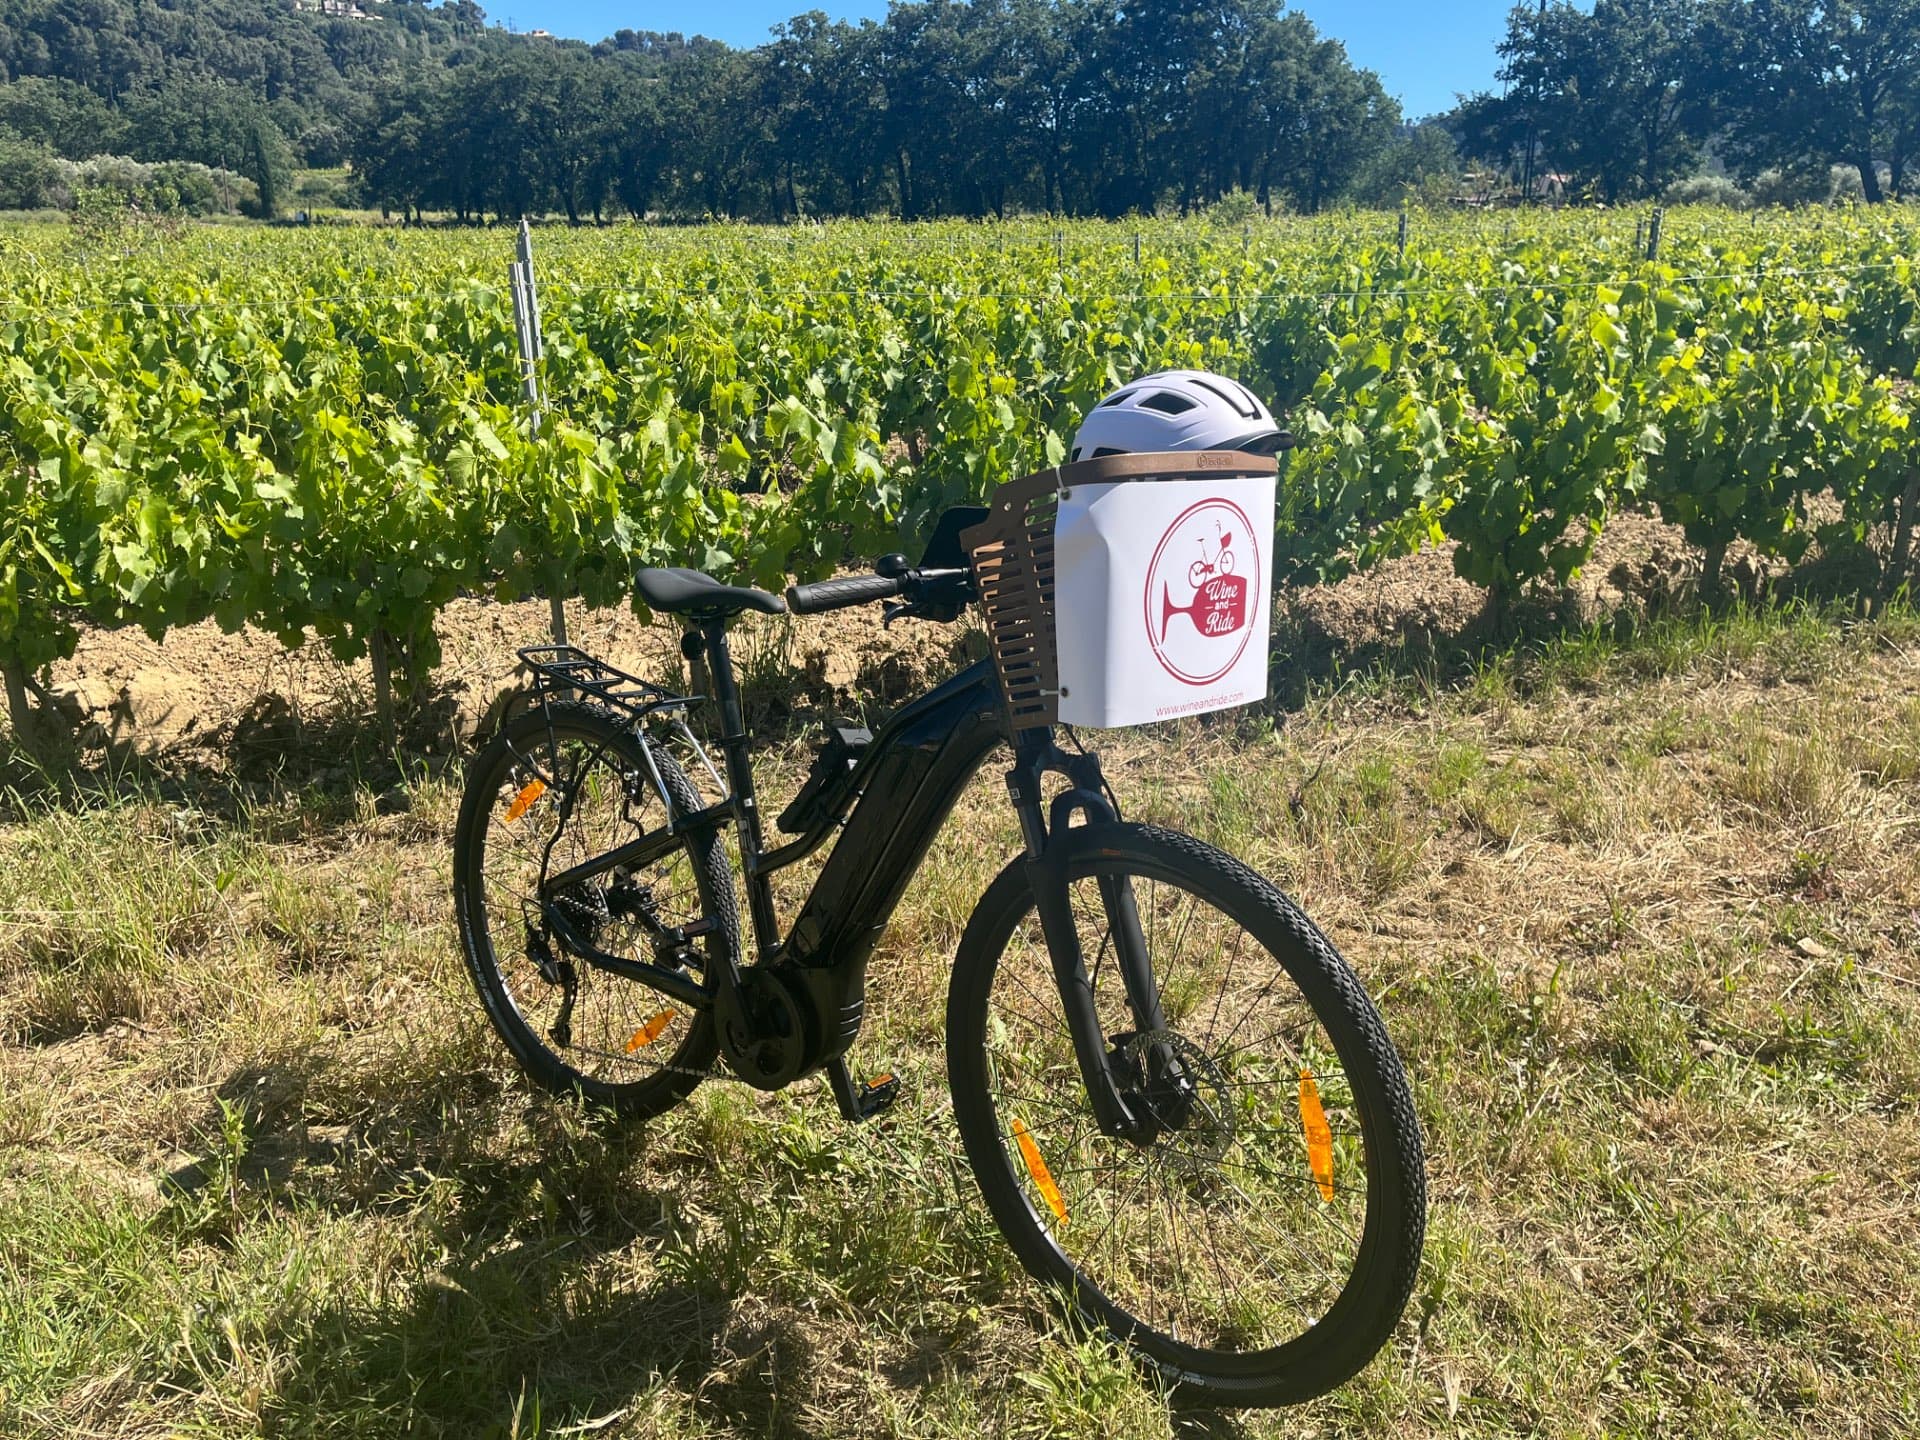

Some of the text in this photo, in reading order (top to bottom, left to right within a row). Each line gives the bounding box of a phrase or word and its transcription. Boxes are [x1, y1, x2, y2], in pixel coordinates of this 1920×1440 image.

[1205, 580, 1238, 601] Wine
[1214, 598, 1230, 611] and
[1205, 609, 1235, 634] Ride
[1156, 692, 1244, 717] www.wineandride.com
